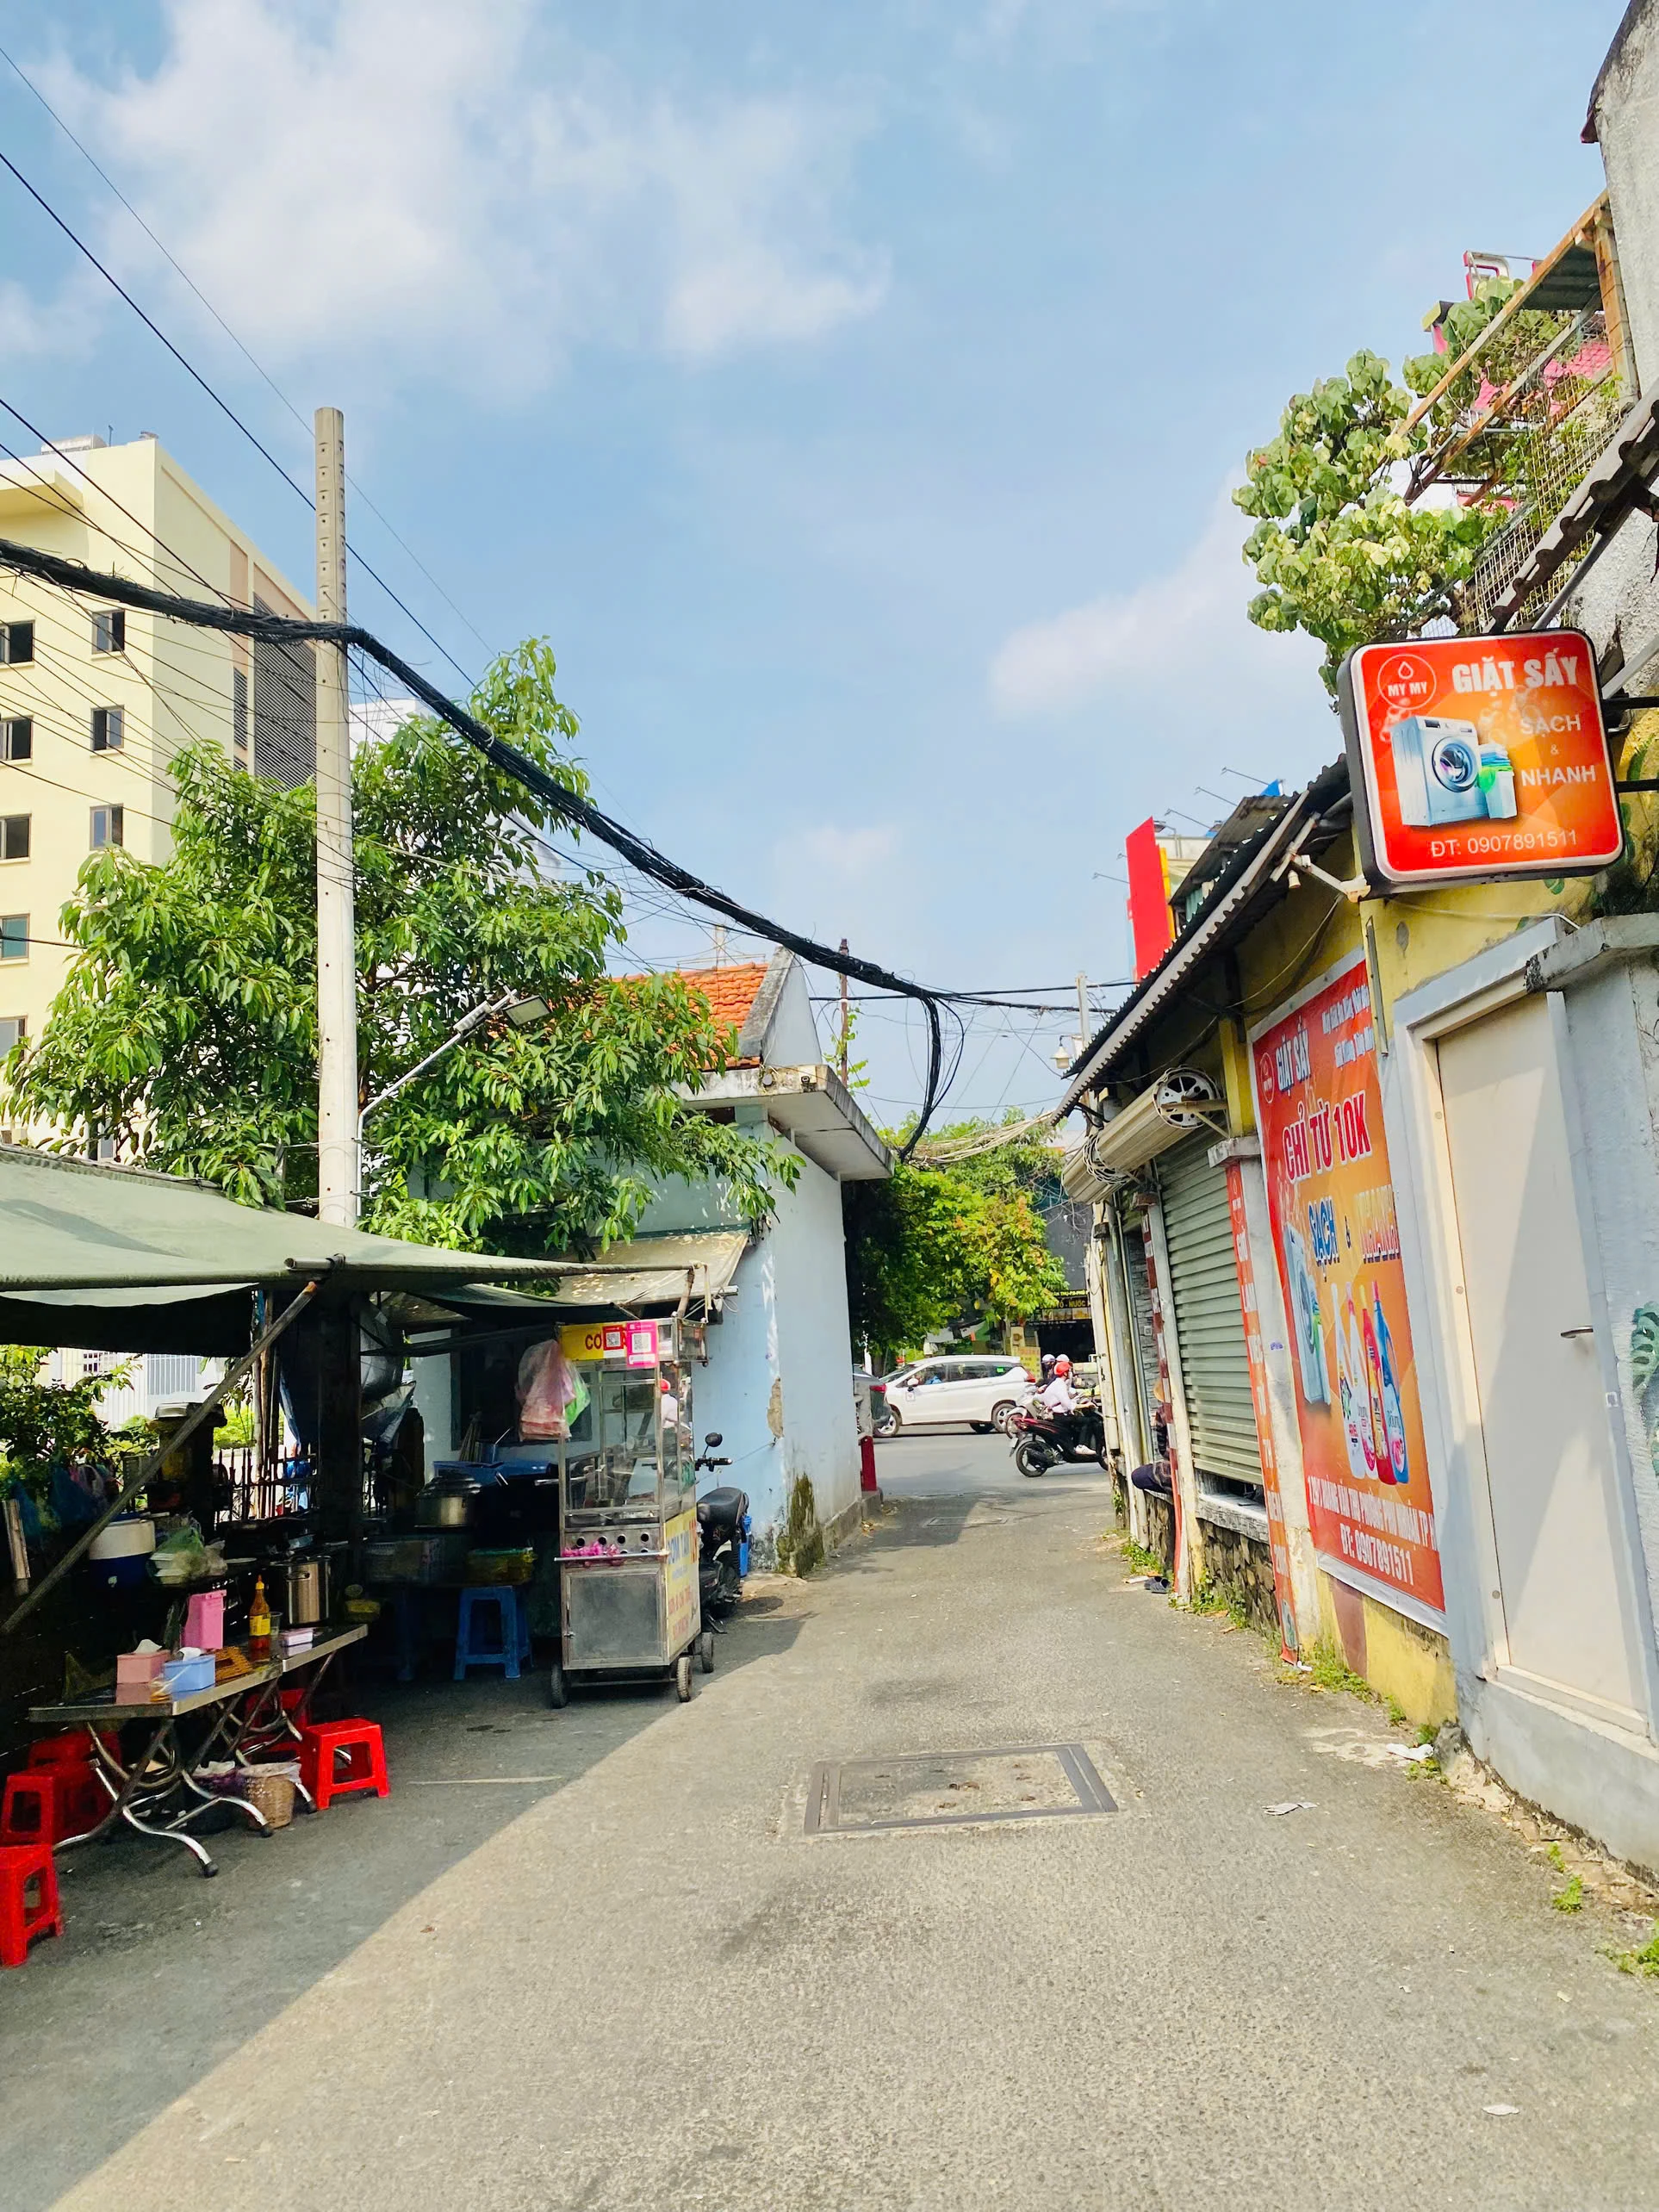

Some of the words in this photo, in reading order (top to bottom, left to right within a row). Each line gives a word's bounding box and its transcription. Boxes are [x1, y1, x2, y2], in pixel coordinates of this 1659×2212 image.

[1388, 684, 1406, 697] MY
[1409, 681, 1427, 695] MY
[1451, 656, 1516, 697] GIẶT
[1523, 648, 1578, 689] SẤY
[1519, 713, 1581, 738] SẠCH
[1550, 743, 1559, 755] &
[1520, 765, 1596, 786] NHANH
[1431, 839, 1462, 858] ĐT:
[1467, 829, 1577, 854] 0907891511
[1276, 1035, 1294, 1097] GIẶT
[1295, 1016, 1311, 1083] SẤY
[1283, 1101, 1311, 1184] CHỈ
[1310, 1097, 1333, 1175] TỪ
[1334, 1090, 1371, 1163] 10K
[1308, 1196, 1339, 1283] SẠCH
[1355, 1184, 1401, 1264] NHANH
[1356, 1529, 1414, 1585] 0907891511
